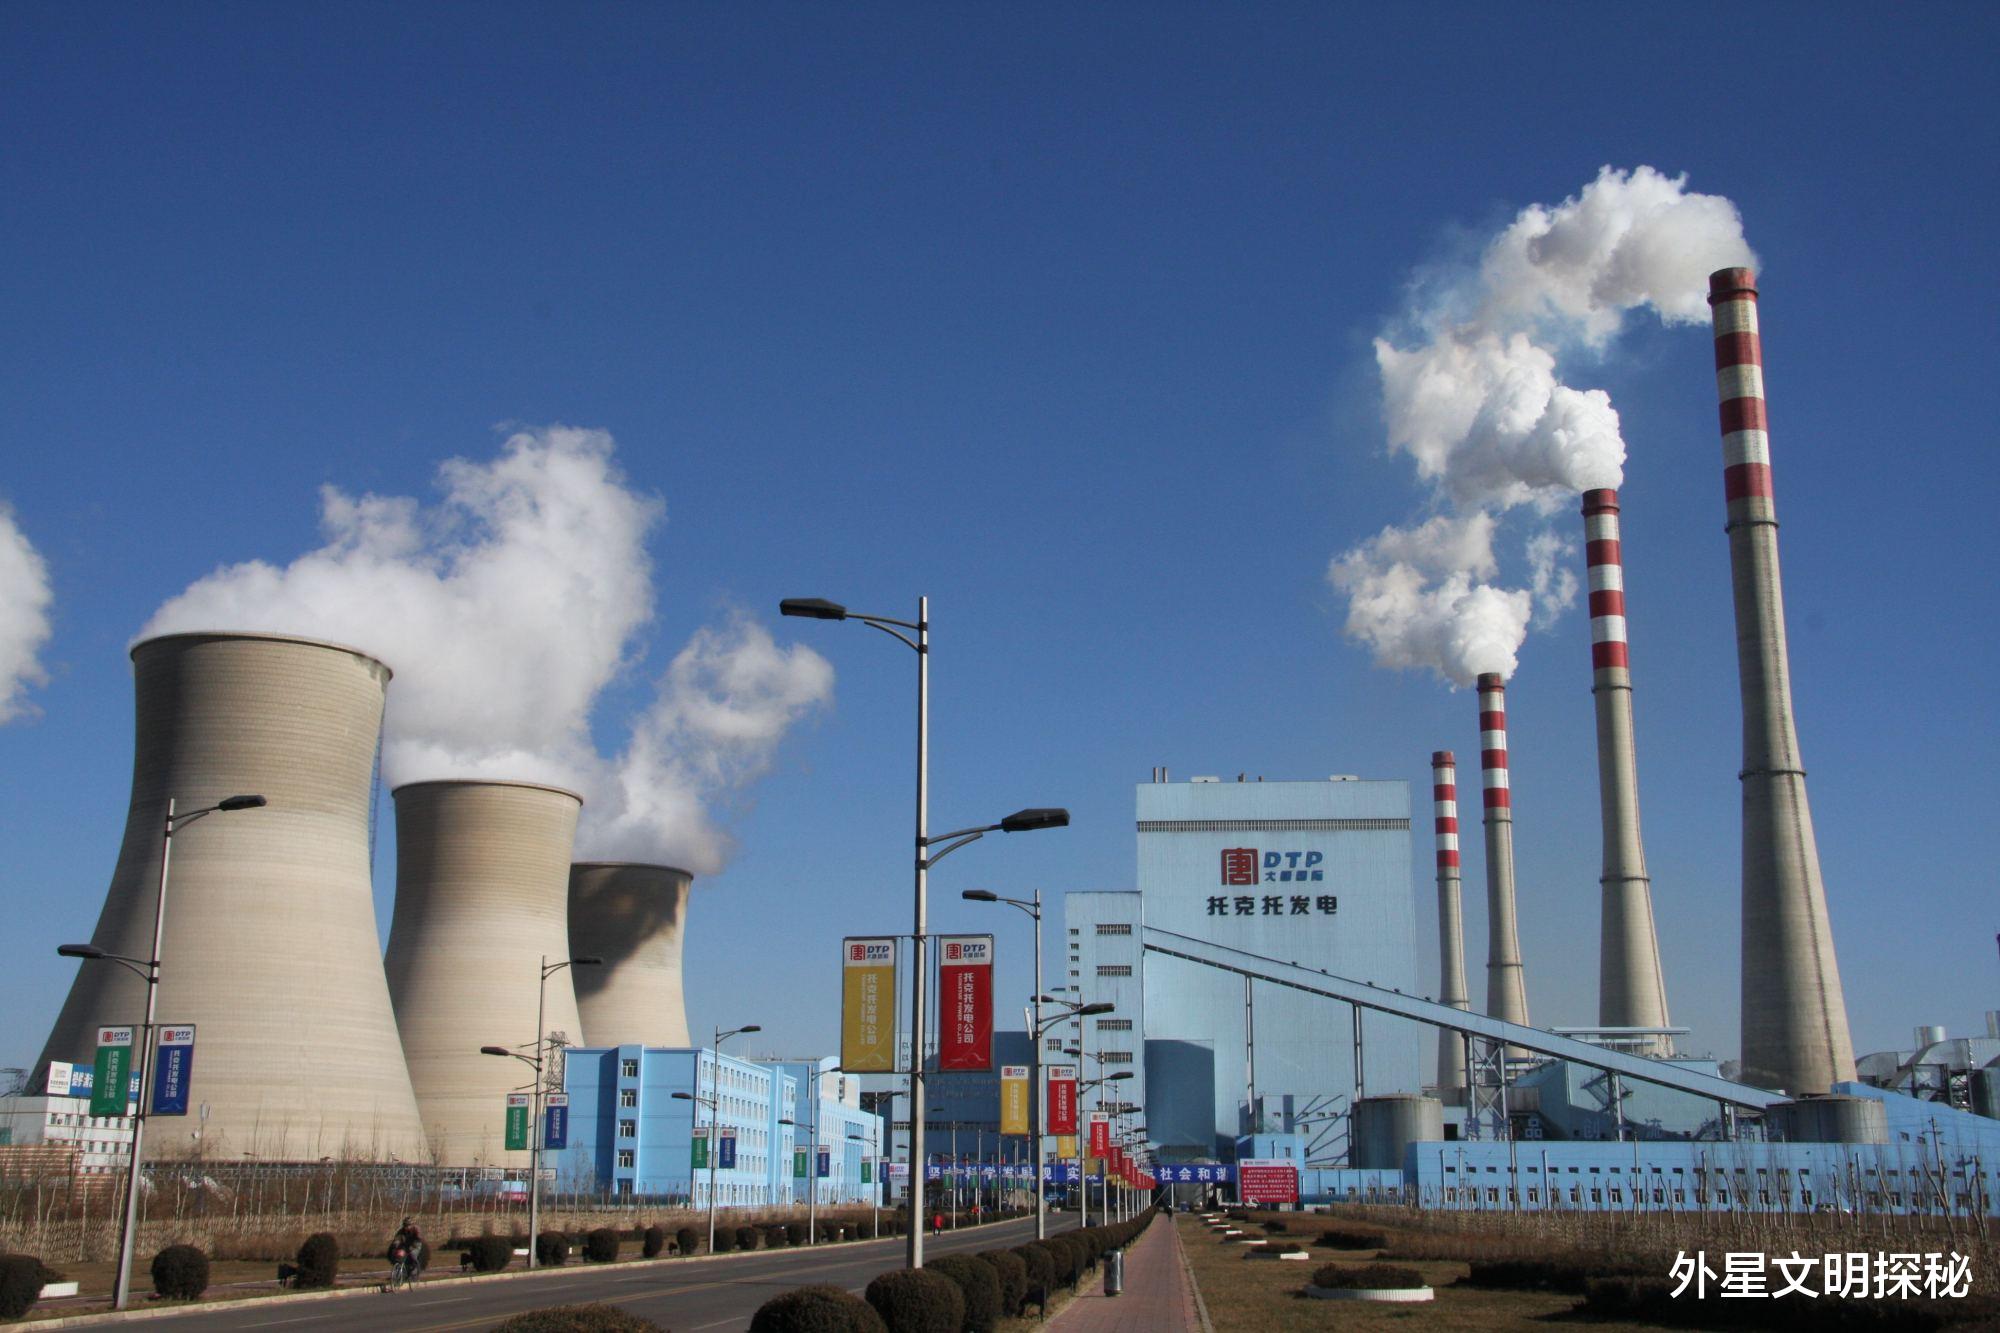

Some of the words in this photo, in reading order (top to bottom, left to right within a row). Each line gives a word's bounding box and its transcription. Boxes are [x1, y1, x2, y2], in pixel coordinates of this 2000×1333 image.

[1264, 851, 1323, 868] DTP
[1207, 895, 1338, 916] 托克托发电
[867, 945, 890, 953] DTP
[963, 943, 986, 952] DTP
[963, 972, 975, 1044] 托克托发电公司
[1160, 1167, 1229, 1181] 社会和谐
